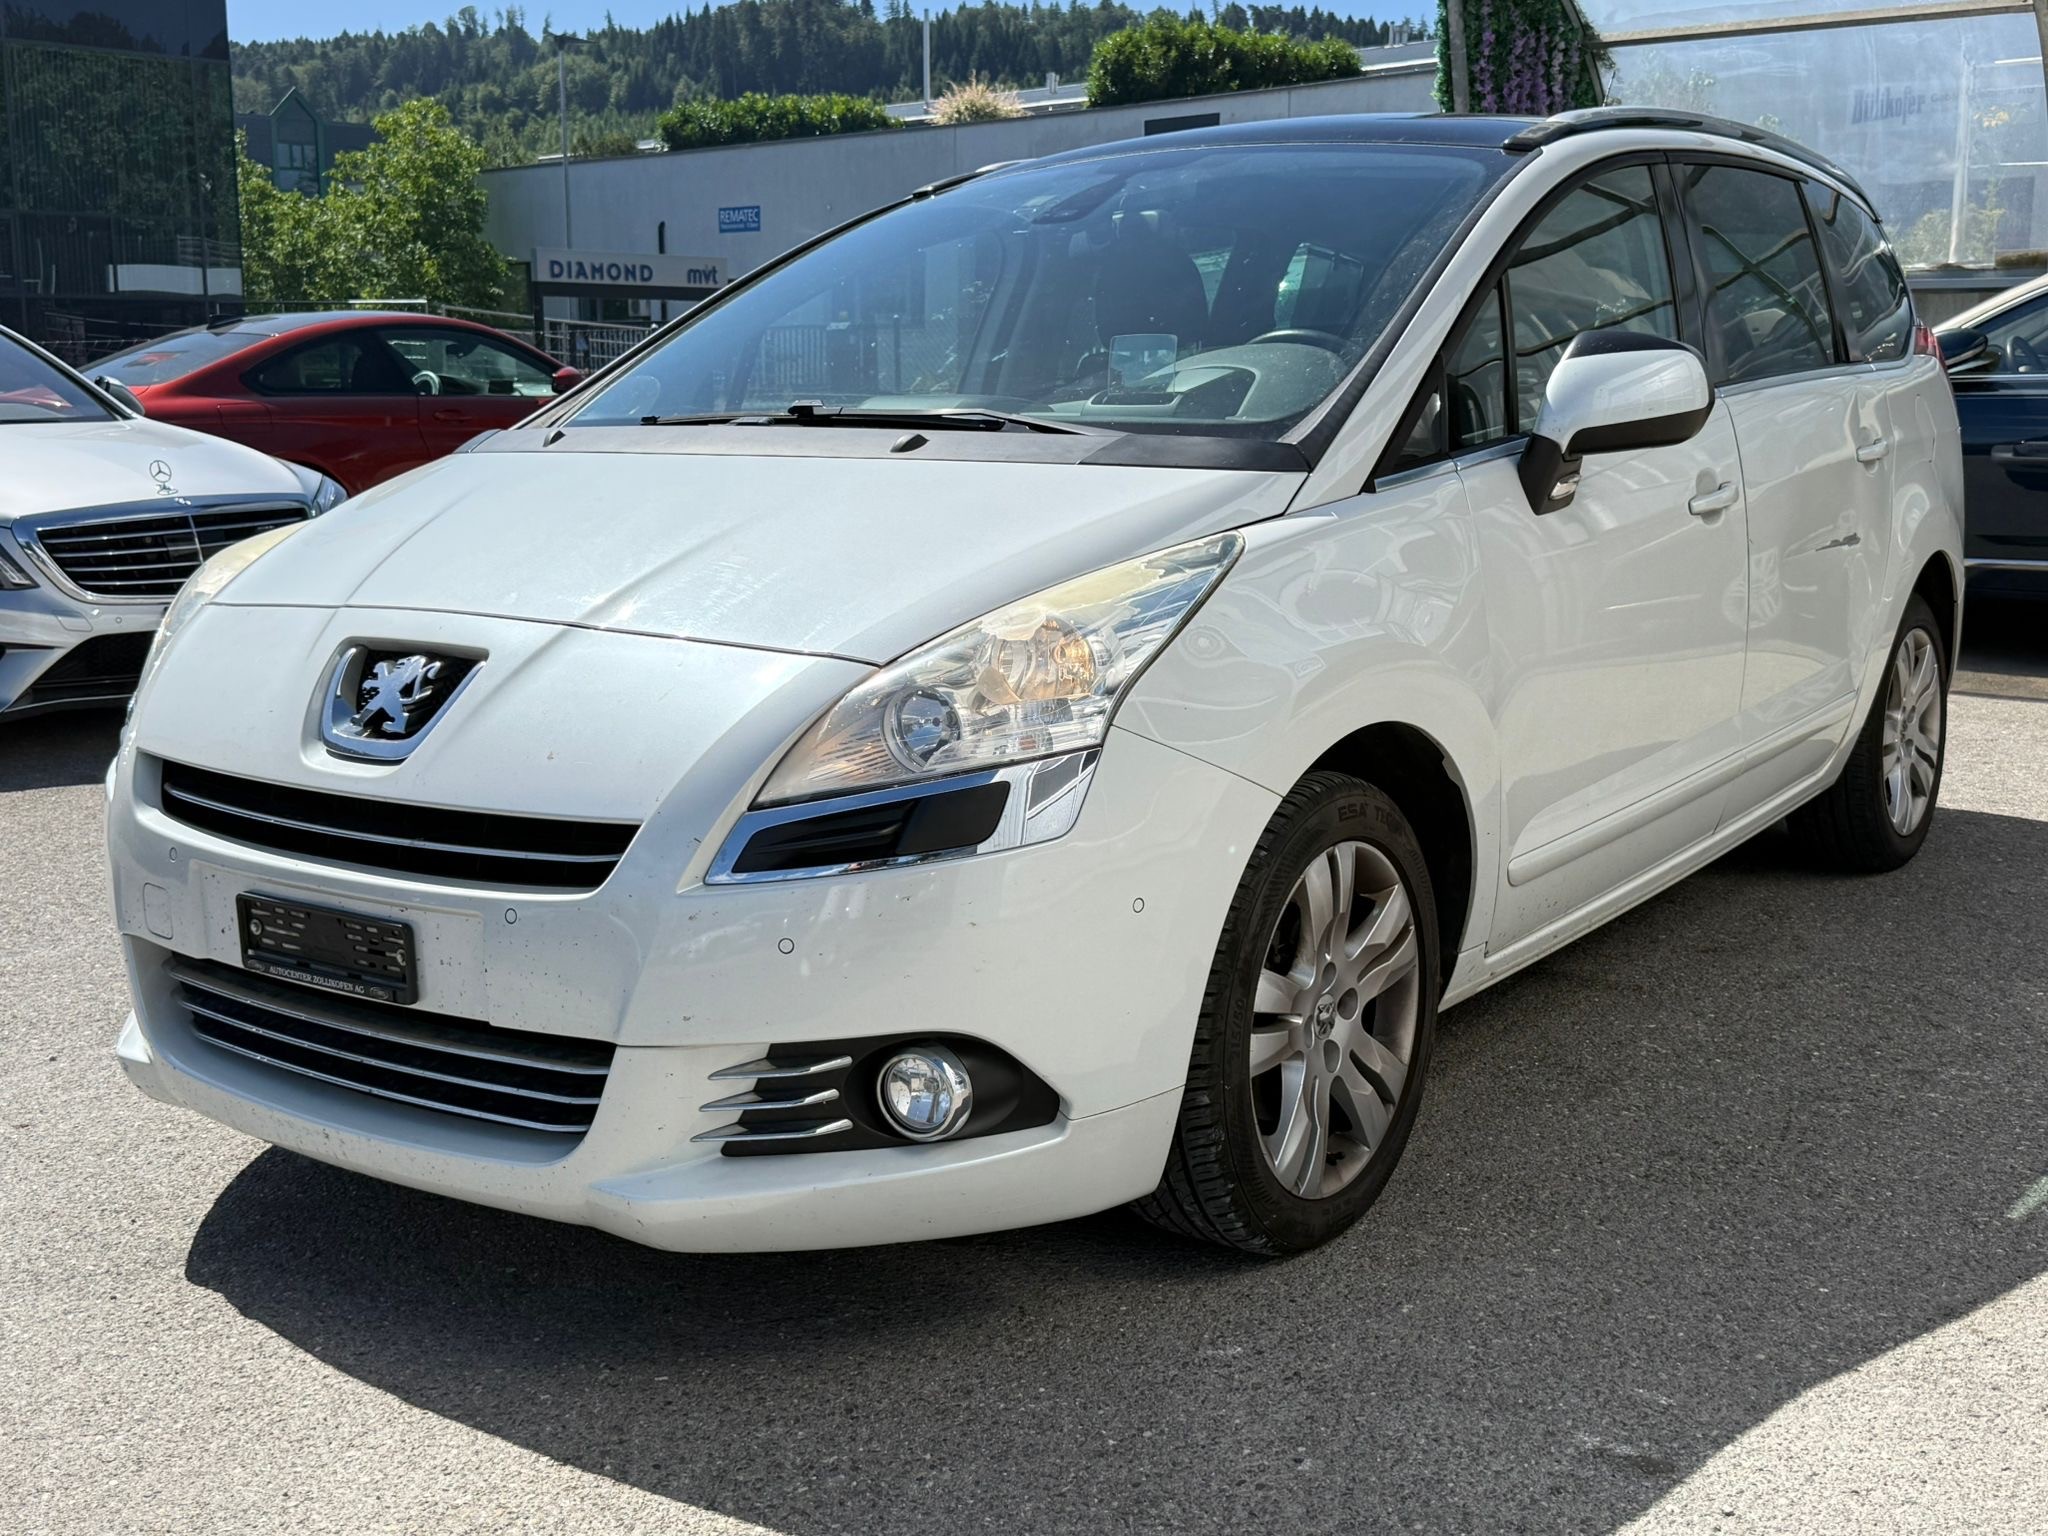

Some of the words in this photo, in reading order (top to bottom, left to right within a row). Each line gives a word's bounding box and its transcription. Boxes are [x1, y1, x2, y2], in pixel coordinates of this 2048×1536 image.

[720, 208, 759, 223] REMATEC
[549, 259, 654, 283] DIAMOND
[269, 965, 313, 982] AUTOCENTER
[312, 975, 354, 991] ZOLLIKOFEN
[354, 983, 365, 994] AG
